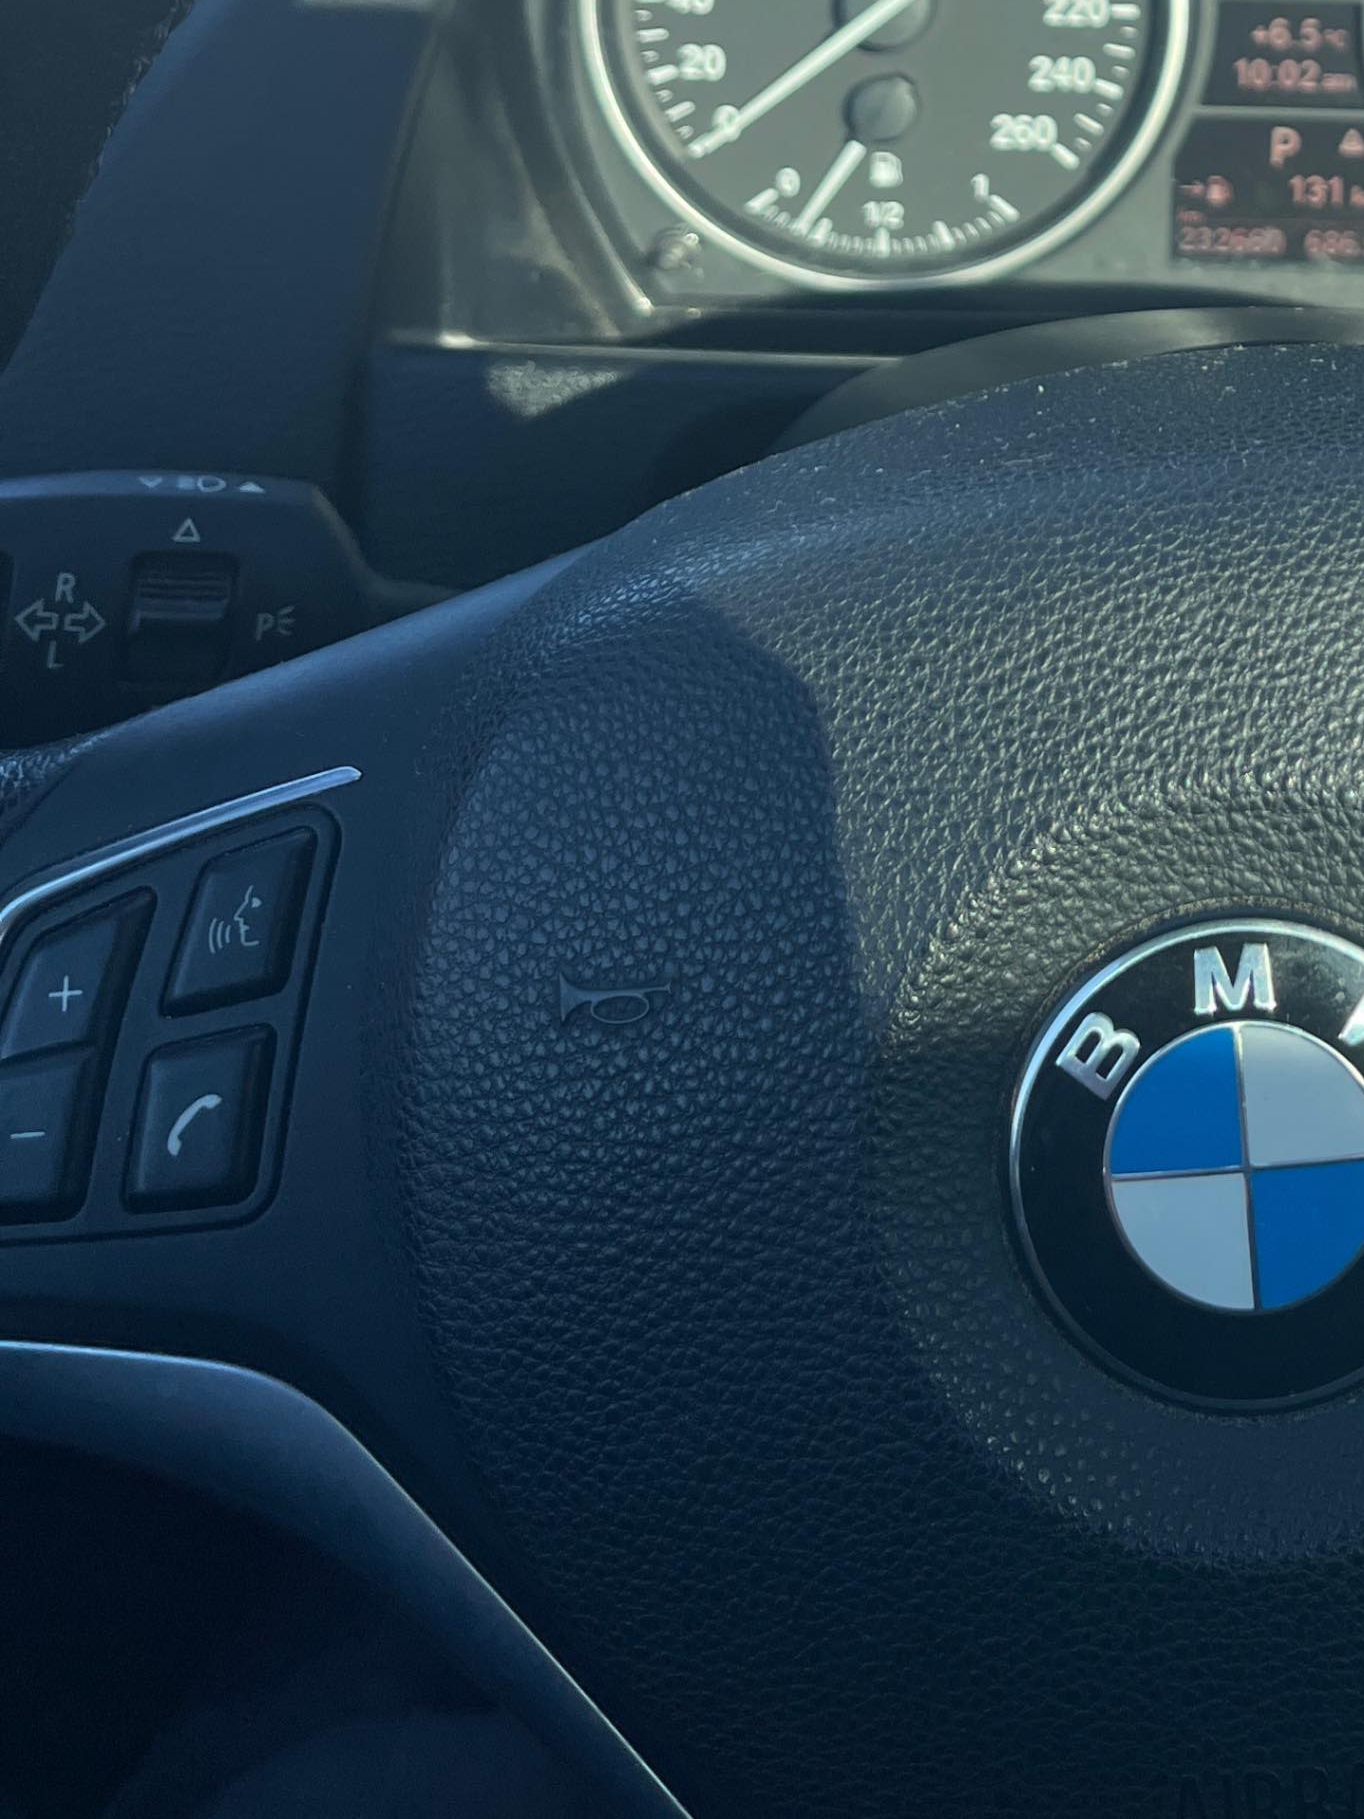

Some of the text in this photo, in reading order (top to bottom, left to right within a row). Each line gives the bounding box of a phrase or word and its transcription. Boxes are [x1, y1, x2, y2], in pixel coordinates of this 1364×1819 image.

[676, 44, 727, 82] 20
[1028, 55, 1096, 93] 240
[1233, 57, 1321, 93] 10:02
[989, 114, 1057, 152] 260
[1269, 125, 1302, 169] P
[775, 166, 800, 197] 0
[970, 172, 990, 200] 1
[1289, 174, 1345, 209] 131
[862, 200, 905, 231] 1/2
[55, 572, 77, 604] R
[46, 640, 65, 670] L
